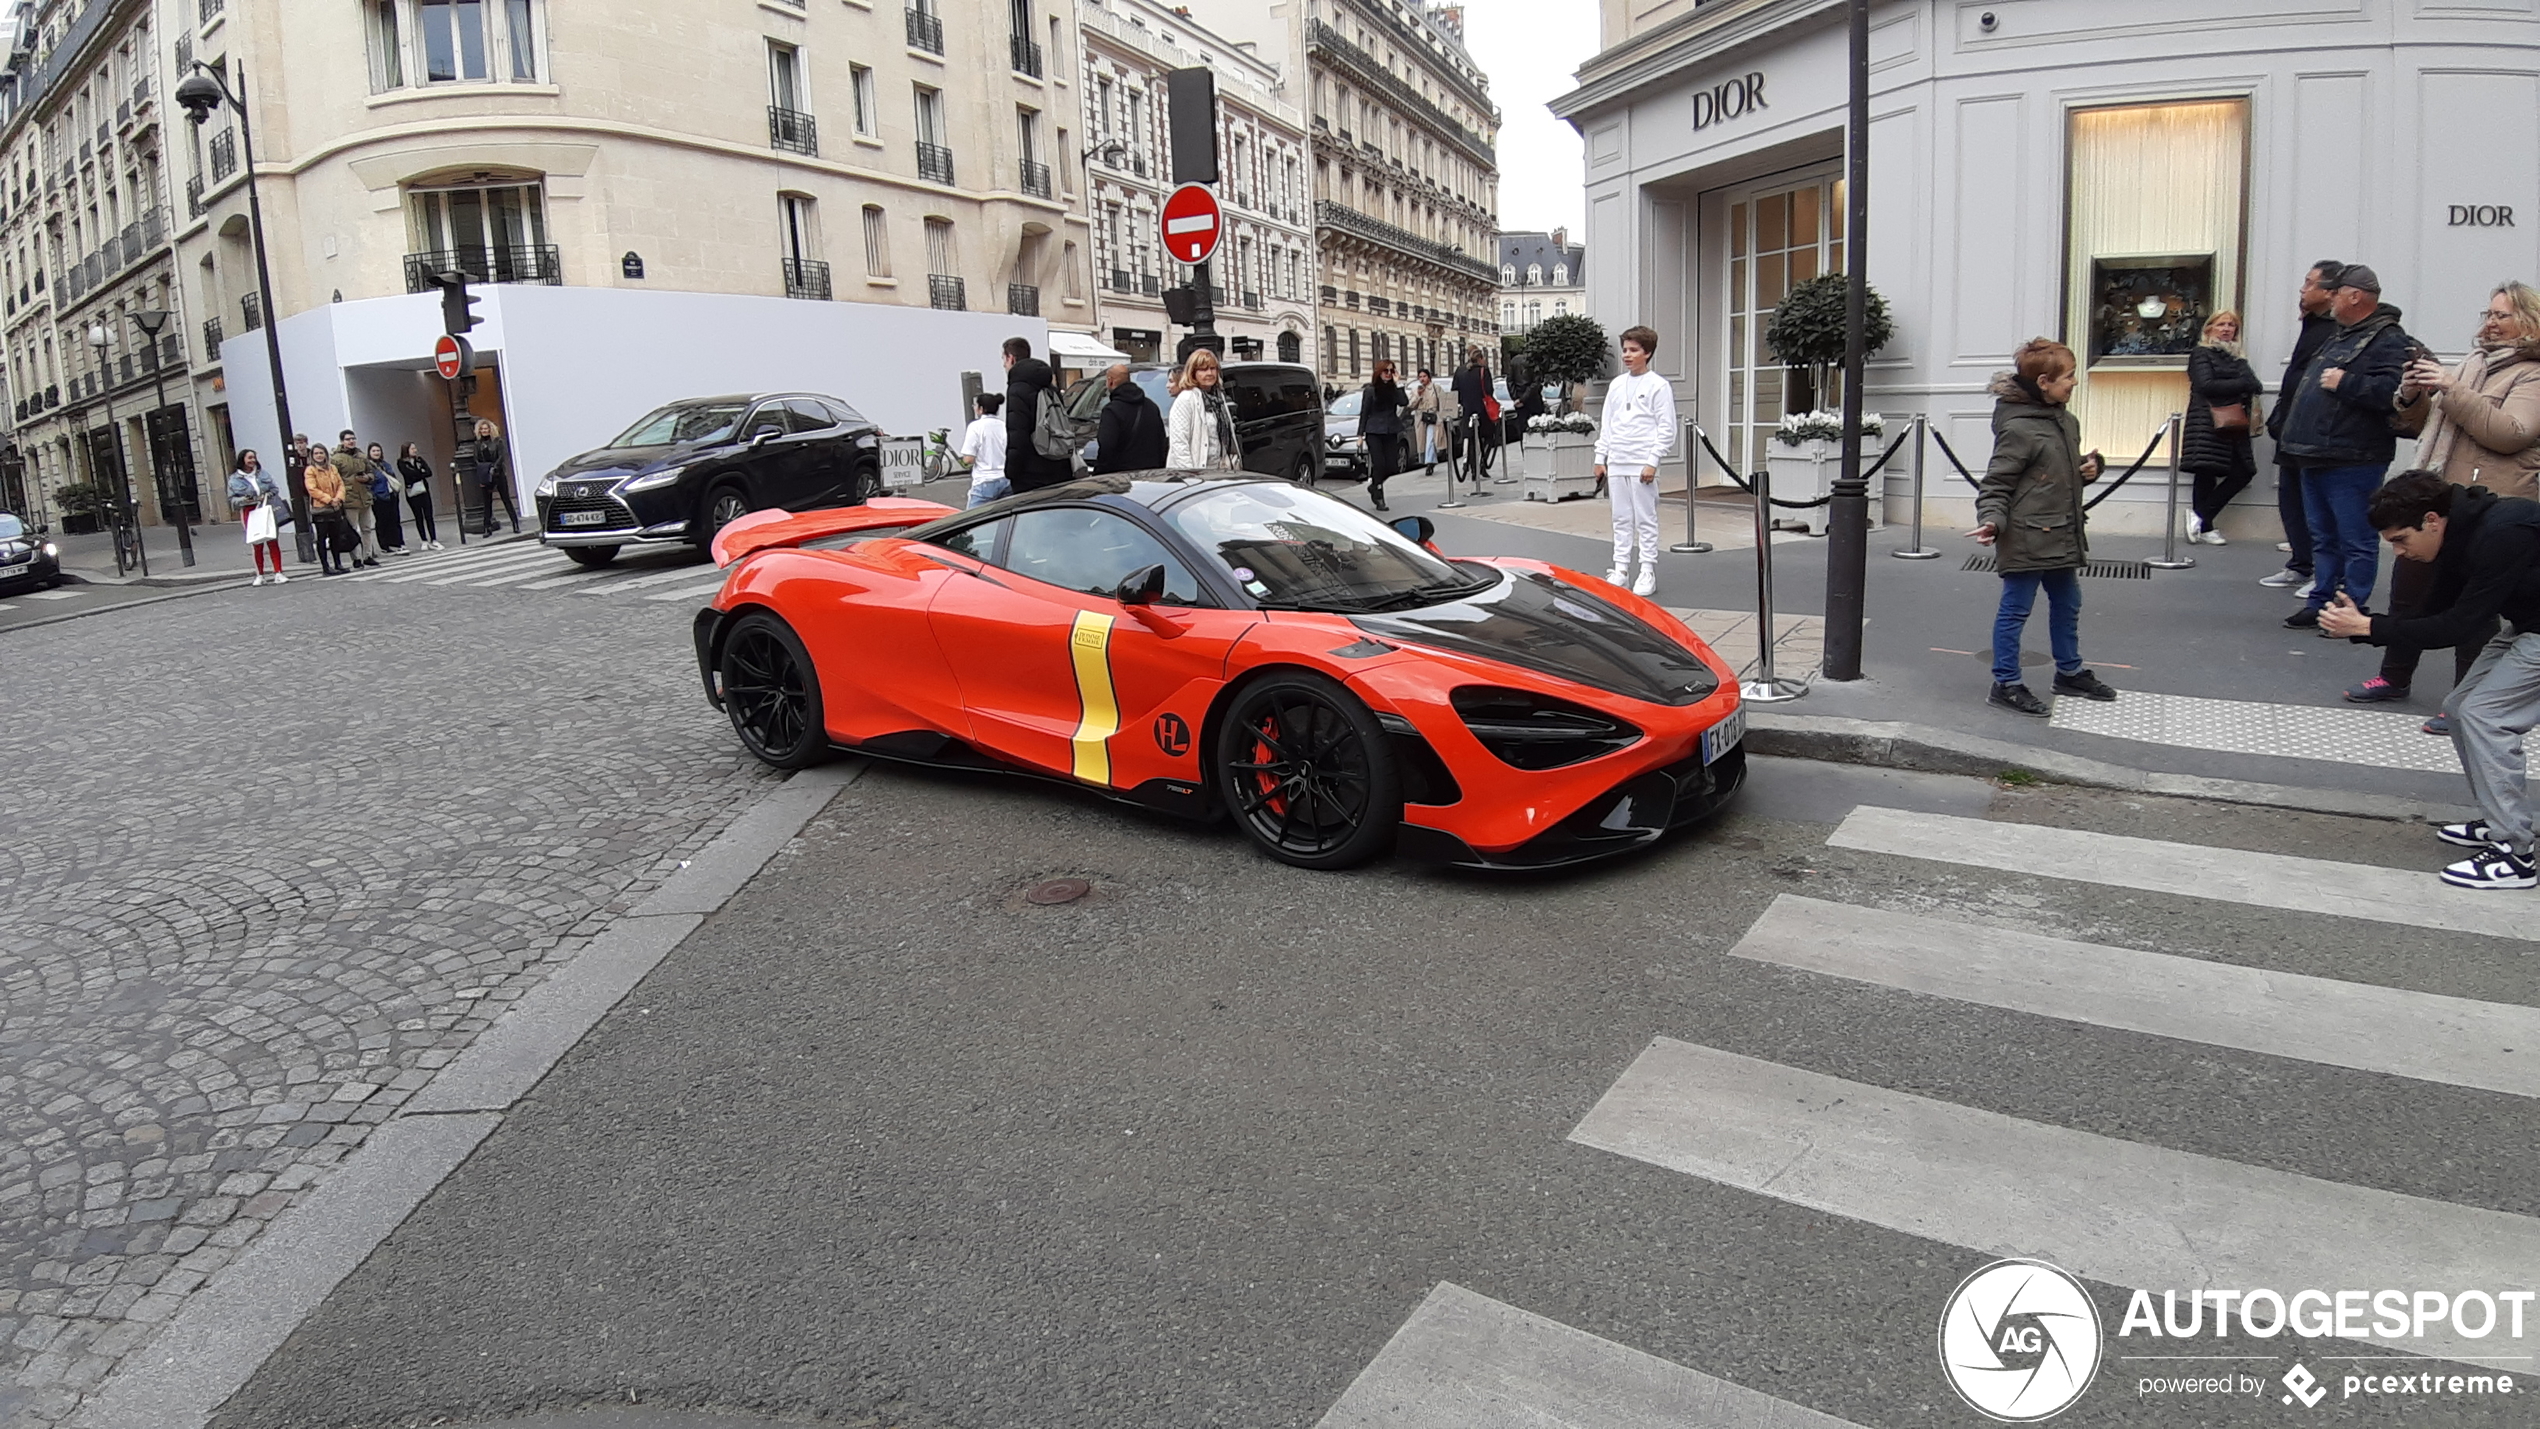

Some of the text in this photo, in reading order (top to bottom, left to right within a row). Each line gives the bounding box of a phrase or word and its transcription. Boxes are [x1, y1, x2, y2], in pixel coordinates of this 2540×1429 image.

[1691, 71, 1769, 132] DIOR
[2447, 204, 2516, 227] DIOR
[883, 448, 920, 467] DIOR
